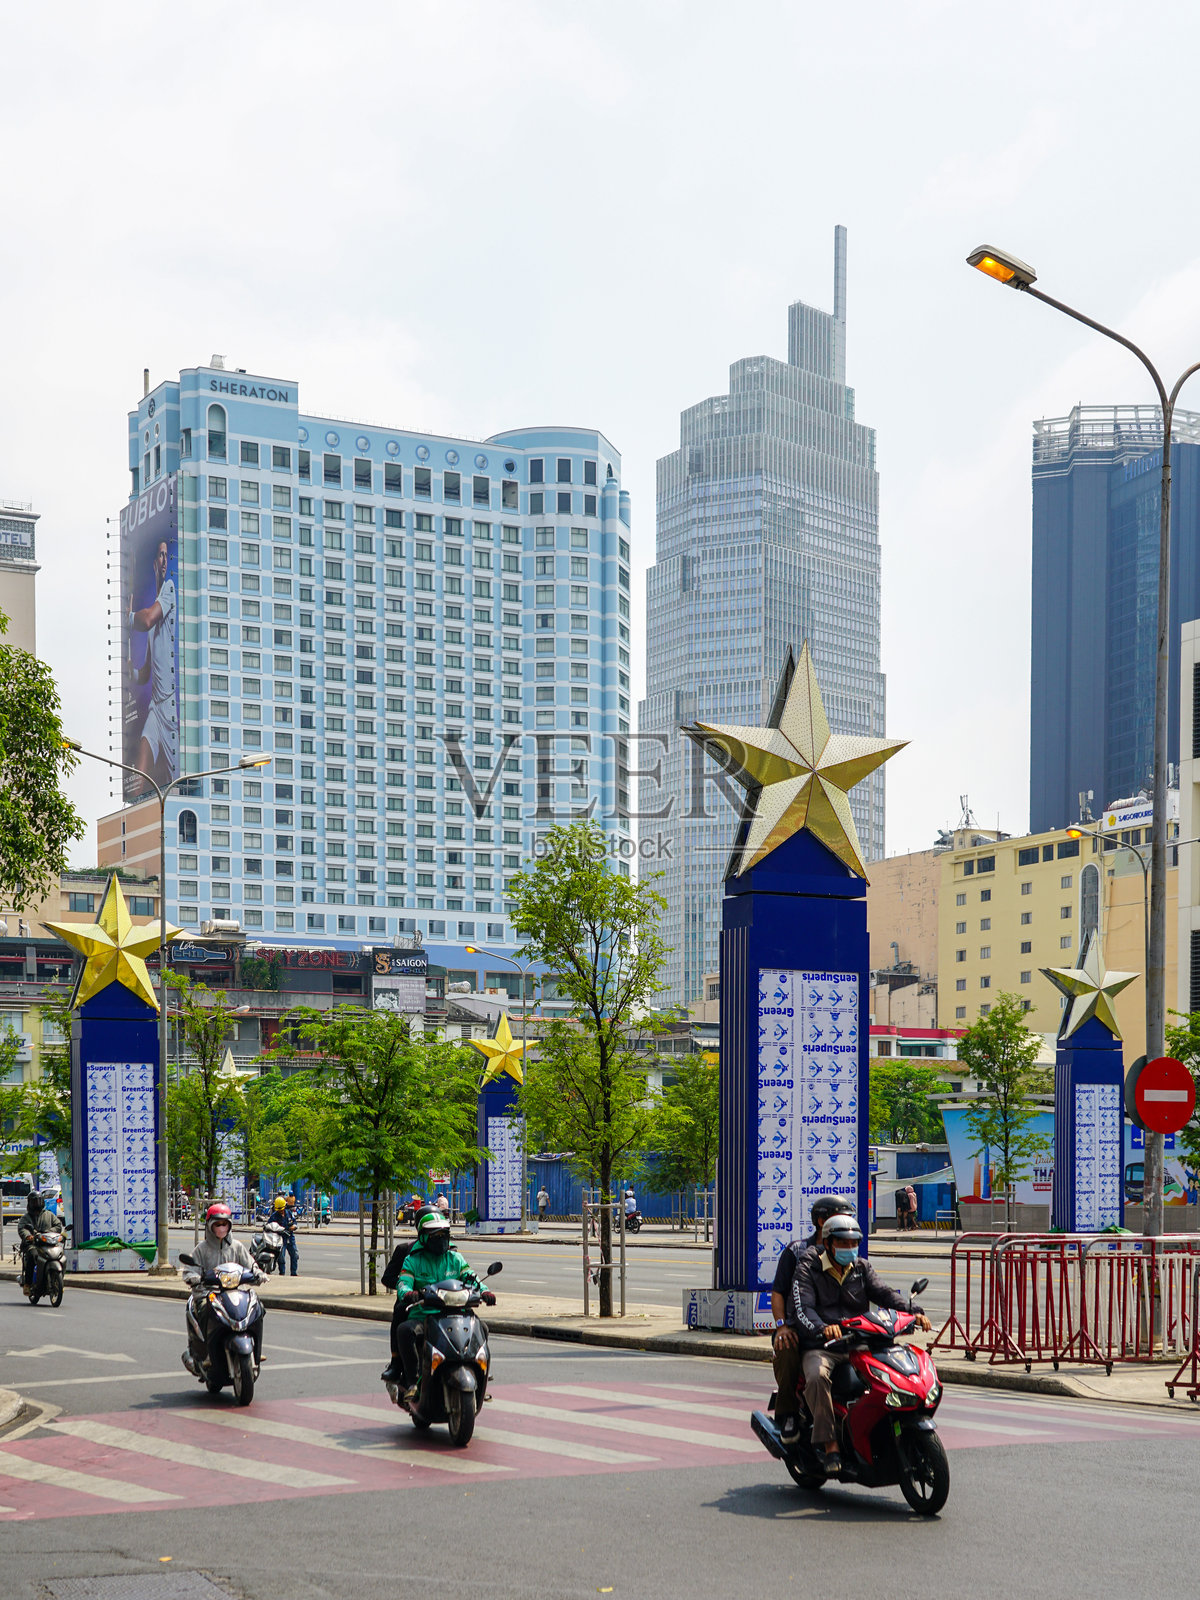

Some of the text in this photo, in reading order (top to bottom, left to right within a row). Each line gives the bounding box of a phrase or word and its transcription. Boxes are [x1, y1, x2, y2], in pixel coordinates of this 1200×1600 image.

[210, 380, 289, 403] SHERATON
[121, 475, 177, 538] HUBLOT
[0, 532, 28, 546] TEL
[297, 950, 349, 967] ZONE
[395, 959, 427, 967] SAIGON
[802, 972, 857, 984] eenSuperis
[802, 1043, 857, 1055] eenSuperis
[801, 1114, 857, 1126] eenSuperis
